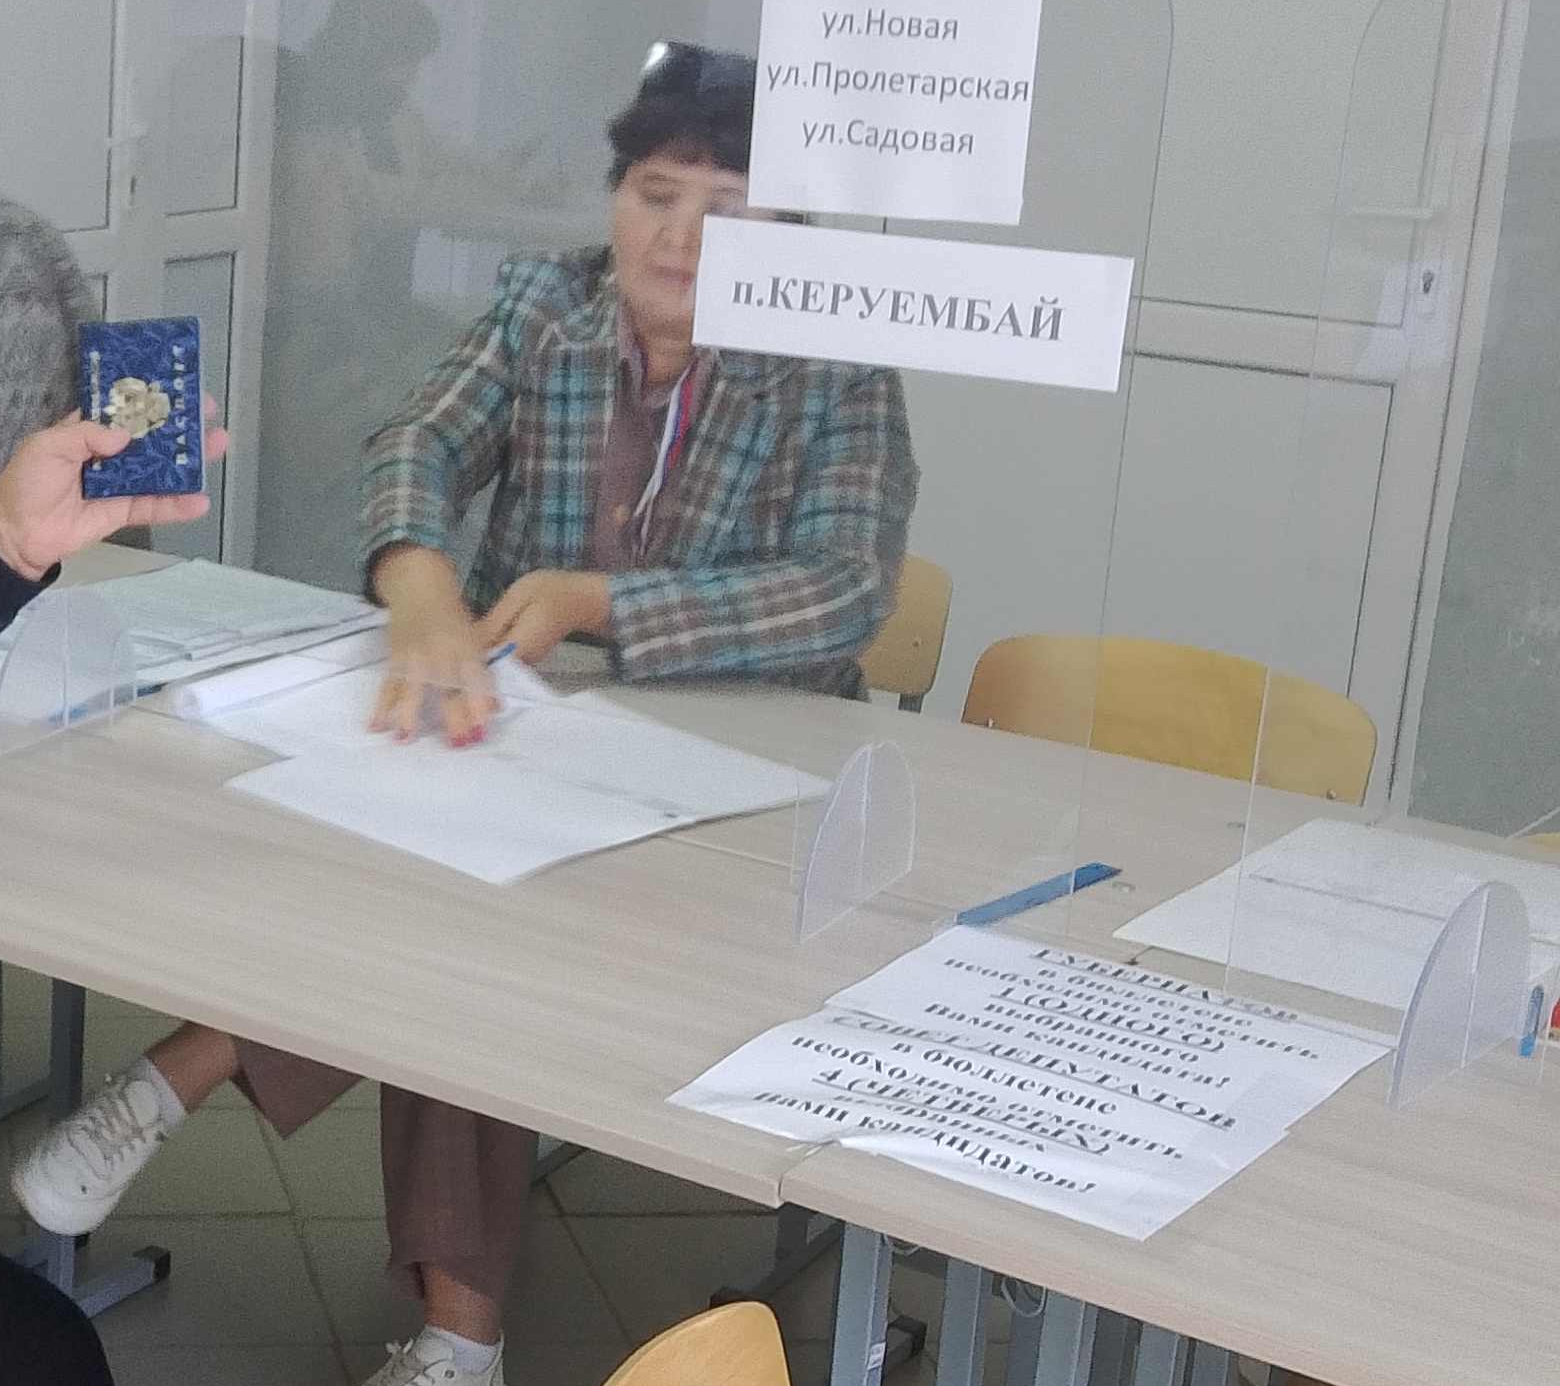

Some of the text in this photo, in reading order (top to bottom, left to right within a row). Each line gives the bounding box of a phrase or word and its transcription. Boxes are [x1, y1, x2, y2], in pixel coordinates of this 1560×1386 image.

[821, 8, 959, 41] ул.Новая
[766, 60, 1030, 103] ул.Пролетарская
[802, 119, 975, 155] ул.Садовая
[732, 276, 1064, 341] п.КЕРУЕМБАЙ
[1025, 992, 1228, 1052] (ОДНОГО)
[790, 1036, 1002, 1104] необходимо
[819, 1066, 847, 1082] 4
[918, 1049, 1122, 1115] бюллетене
